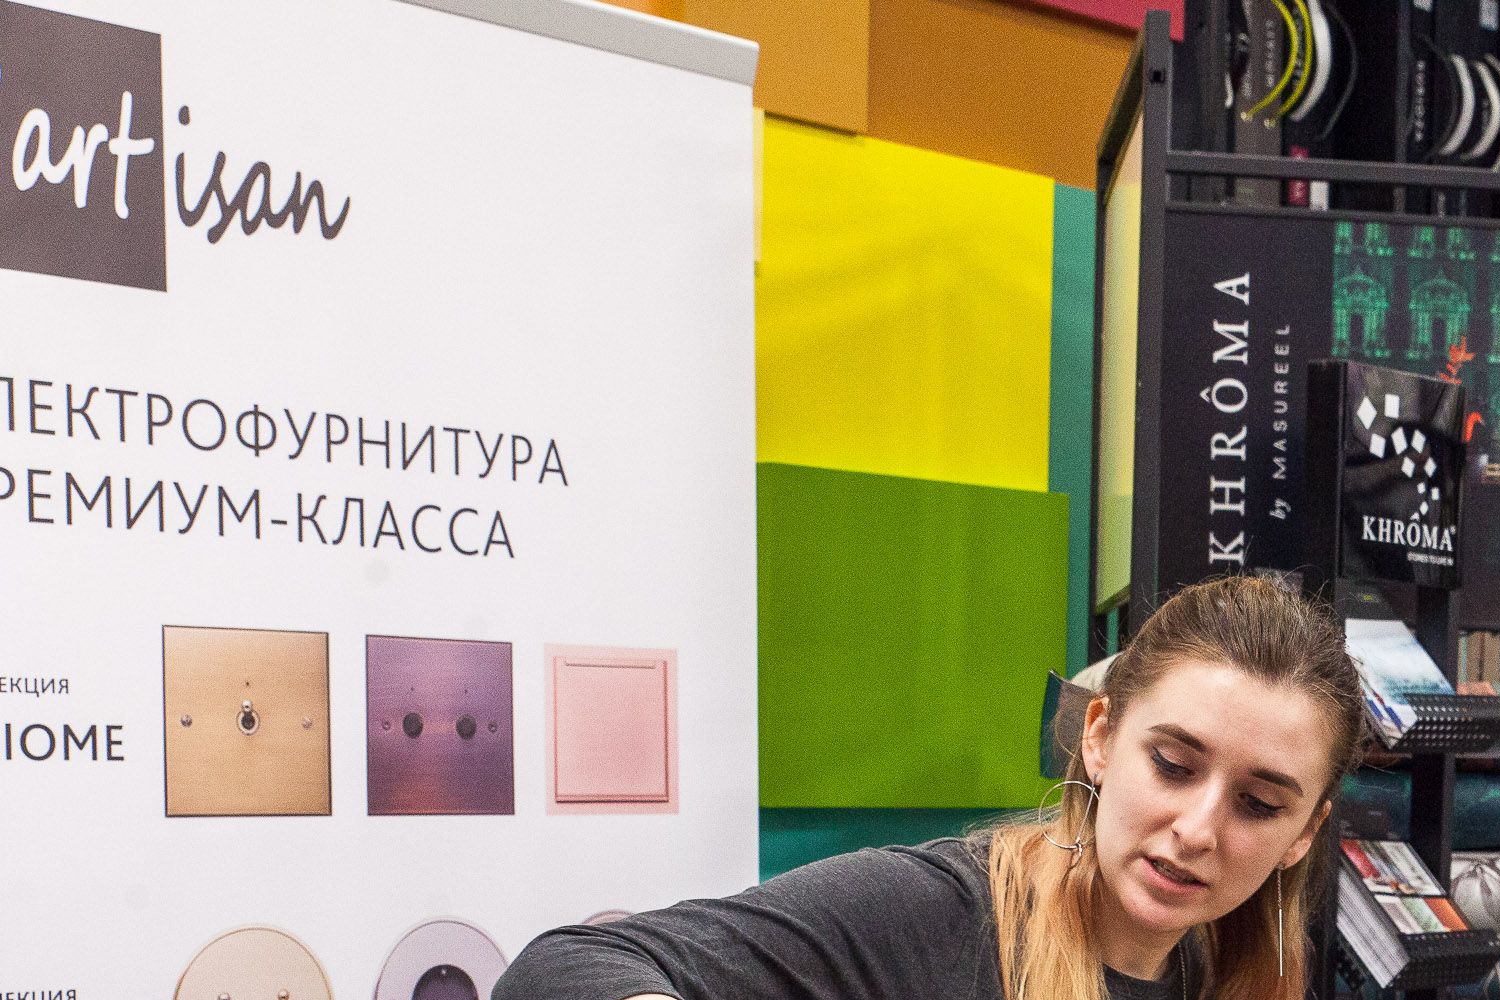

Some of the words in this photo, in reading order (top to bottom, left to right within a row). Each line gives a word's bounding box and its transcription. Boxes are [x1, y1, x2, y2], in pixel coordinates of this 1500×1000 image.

[0, 72, 350, 244] artisan
[1200, 271, 1250, 566] KHRÔMA
[1272, 324, 1290, 480] MASUREEL
[0, 466, 516, 558] РЕМИУМ-КЛАССА
[1269, 498, 1291, 520] by
[5, 723, 124, 761] IOME
